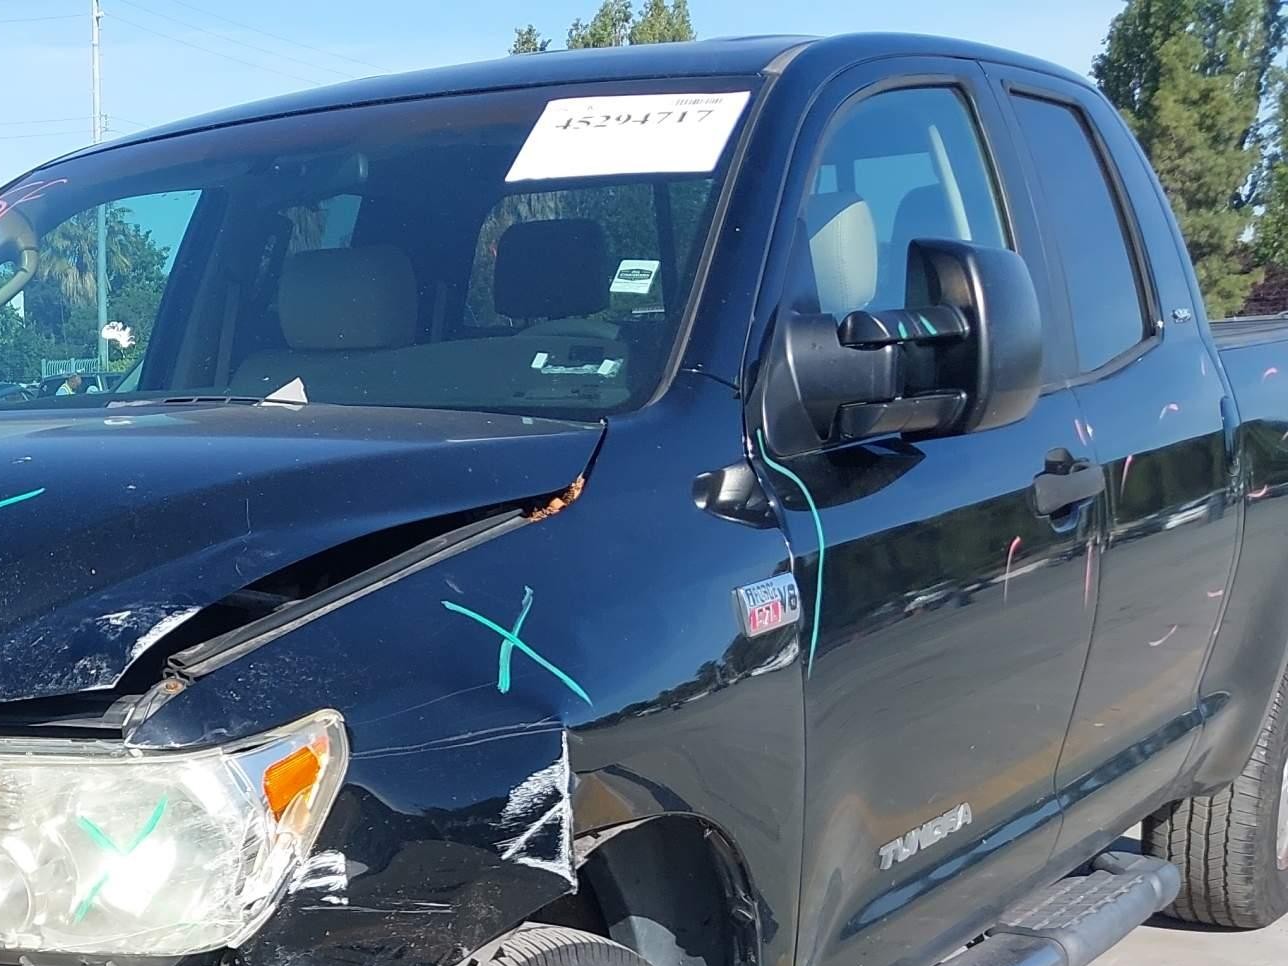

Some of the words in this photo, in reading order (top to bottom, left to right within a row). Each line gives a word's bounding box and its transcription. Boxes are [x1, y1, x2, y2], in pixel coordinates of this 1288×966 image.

[555, 109, 714, 130] 45294717
[777, 583, 798, 613] V8
[878, 802, 972, 870] TUNDRA
